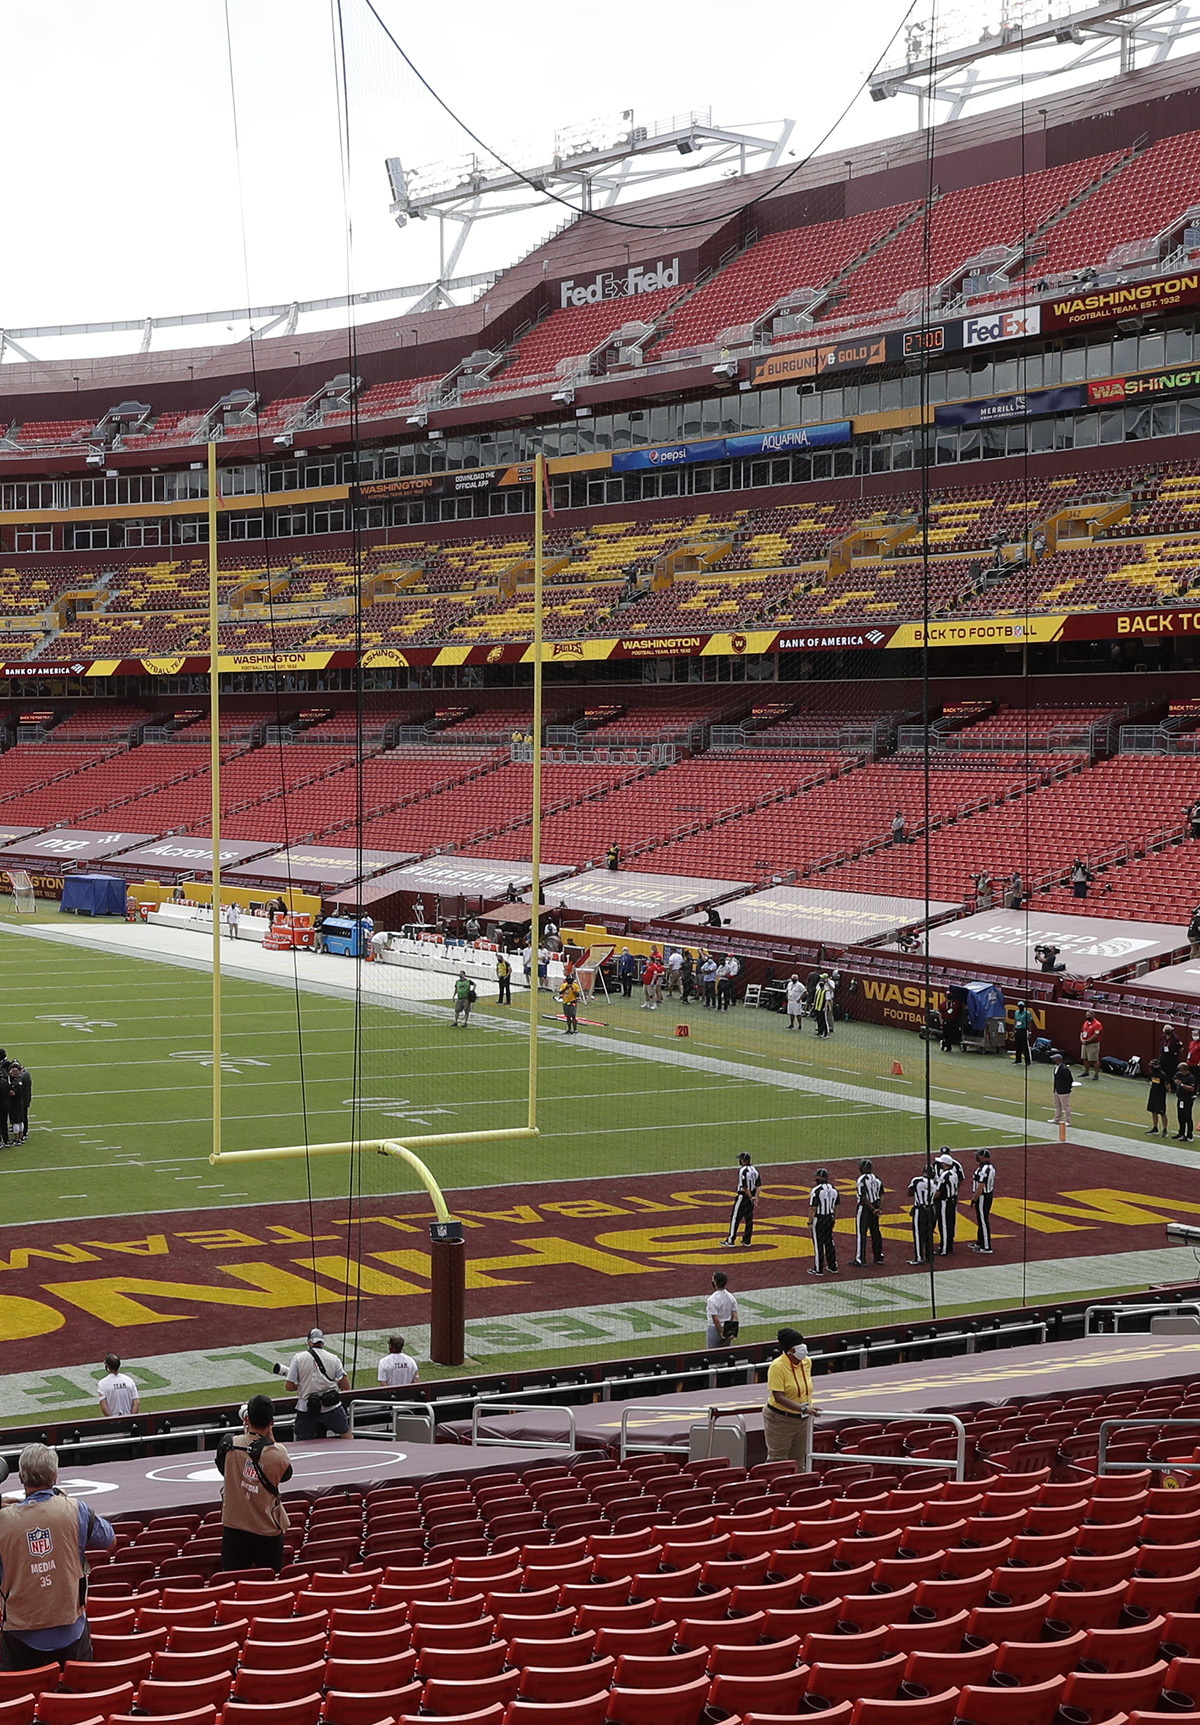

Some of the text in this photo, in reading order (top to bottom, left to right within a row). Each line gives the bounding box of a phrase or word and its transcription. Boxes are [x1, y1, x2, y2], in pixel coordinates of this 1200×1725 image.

[969, 268, 981, 277] 453
[560, 257, 679, 309] FedExField
[1052, 276, 1199, 316] WASHINGTON
[1068, 295, 1181, 323] FOOTBALL TEAM, EST. 1932
[967, 313, 1030, 344] FedEx
[767, 349, 867, 376] BURGUNDY & GOLD
[980, 404, 1014, 416] MERRILL
[761, 430, 810, 450] AQUAFINA
[660, 448, 687, 464] pepsi
[455, 472, 485, 483] DOWNLOAD
[359, 479, 433, 495] WASHINGTON
[455, 481, 478, 490] OFFICIAL
[1117, 614, 1173, 634] BACK
[779, 634, 864, 648] BANK OF AMERICA
[915, 627, 966, 641] BACK TO
[622, 638, 700, 650] WASHINGTON
[232, 653, 306, 664] WASHINGTON
[27, 667, 36, 675] OF
[37, 667, 70, 675] AMERICA
[34, 838, 91, 853] nrg
[271, 853, 391, 868] WASHINGTON
[399, 866, 533, 885] BURGUNDY
[617, 887, 698, 903] GOLD
[737, 899, 919, 925] WASHINGTON
[988, 925, 1098, 945] UNITED
[676, 1025, 689, 1037] 20
[820, 1282, 931, 1309] IT
[113, 1382, 126, 1390] TEAM
[31, 1538, 53, 1553] NFL
[30, 1560, 57, 1574] MEDIA
[40, 1574, 52, 1587] 35
